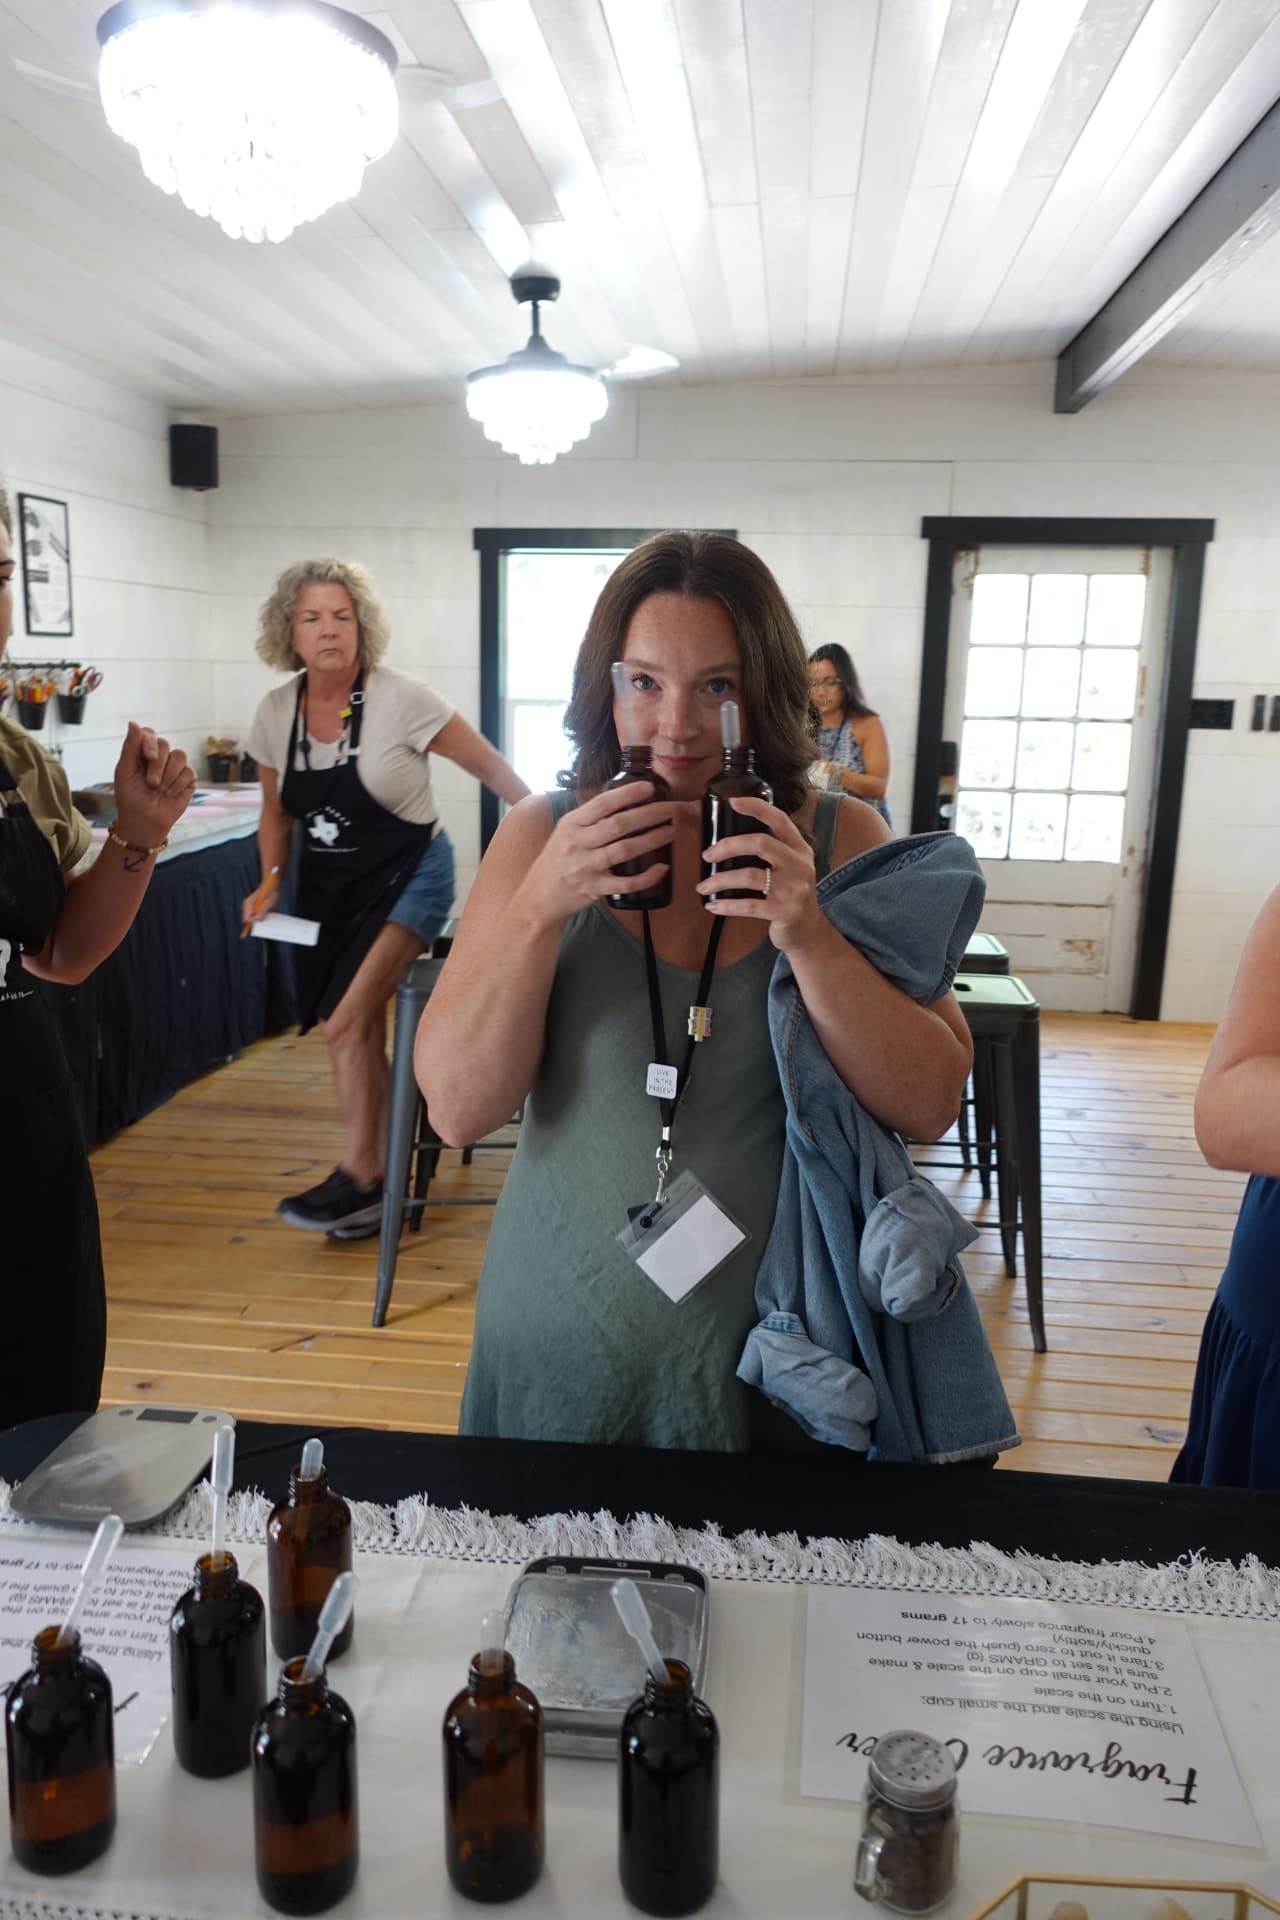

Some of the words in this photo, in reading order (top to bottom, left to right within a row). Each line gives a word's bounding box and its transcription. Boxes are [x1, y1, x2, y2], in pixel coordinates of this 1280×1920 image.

[0, 1558, 24, 1567] gra
[106, 1565, 164, 1577] fragrance
[157, 1593, 179, 1602] are
[1, 1605, 23, 1616] the
[26, 1607, 44, 1615] on
[153, 1603, 174, 1612] ure
[82, 1609, 111, 1619] sma
[113, 1611, 143, 1622] your
[901, 1611, 948, 1622] grams
[952, 1616, 968, 1625] 17
[972, 1616, 986, 1626] to
[990, 1616, 1034, 1629] slowly
[83, 1626, 106, 1637] the
[108, 1629, 127, 1638] on
[1038, 1622, 1106, 1639] fragrance
[130, 1631, 158, 1644] Turn
[856, 1632, 902, 1644] button
[906, 1636, 951, 1646] power
[954, 1640, 977, 1649] the
[981, 1640, 1021, 1652] (push
[1024, 1644, 1057, 1654] zero
[1052, 1633, 1152, 1655] quickly/softly)
[96, 1645, 119, 1657] the
[123, 1647, 162, 1662] Using
[966, 1650, 984, 1663] (g)
[1060, 1648, 1075, 1658] to
[1079, 1650, 1103, 1659] out
[868, 1657, 908, 1668] make
[988, 1654, 1047, 1667] GRAMS
[1106, 1653, 1116, 1663] it
[912, 1661, 923, 1670] &
[927, 1662, 965, 1672] scale
[969, 1665, 992, 1674] the
[1051, 1659, 1067, 1669] to
[1071, 1660, 1094, 1670] set
[1097, 1664, 1109, 1674] is
[996, 1667, 1015, 1675] on
[1020, 1667, 1048, 1678] cup
[1052, 1671, 1091, 1682] small
[1113, 1666, 1123, 1677] it
[1126, 1669, 1159, 1680] sure
[1096, 1676, 1128, 1688] your
[1034, 1687, 1074, 1698] scale
[1078, 1691, 1102, 1702] the
[920, 1695, 955, 1707] cup:
[959, 1699, 999, 1709] small
[1106, 1695, 1126, 1705] on
[1003, 1702, 1027, 1714] the
[1031, 1704, 1061, 1715] and
[1065, 1708, 1106, 1720] scale
[1110, 1714, 1135, 1726] the
[1138, 1716, 1184, 1735] Using
[982, 1742, 1198, 1806] Fragrance
